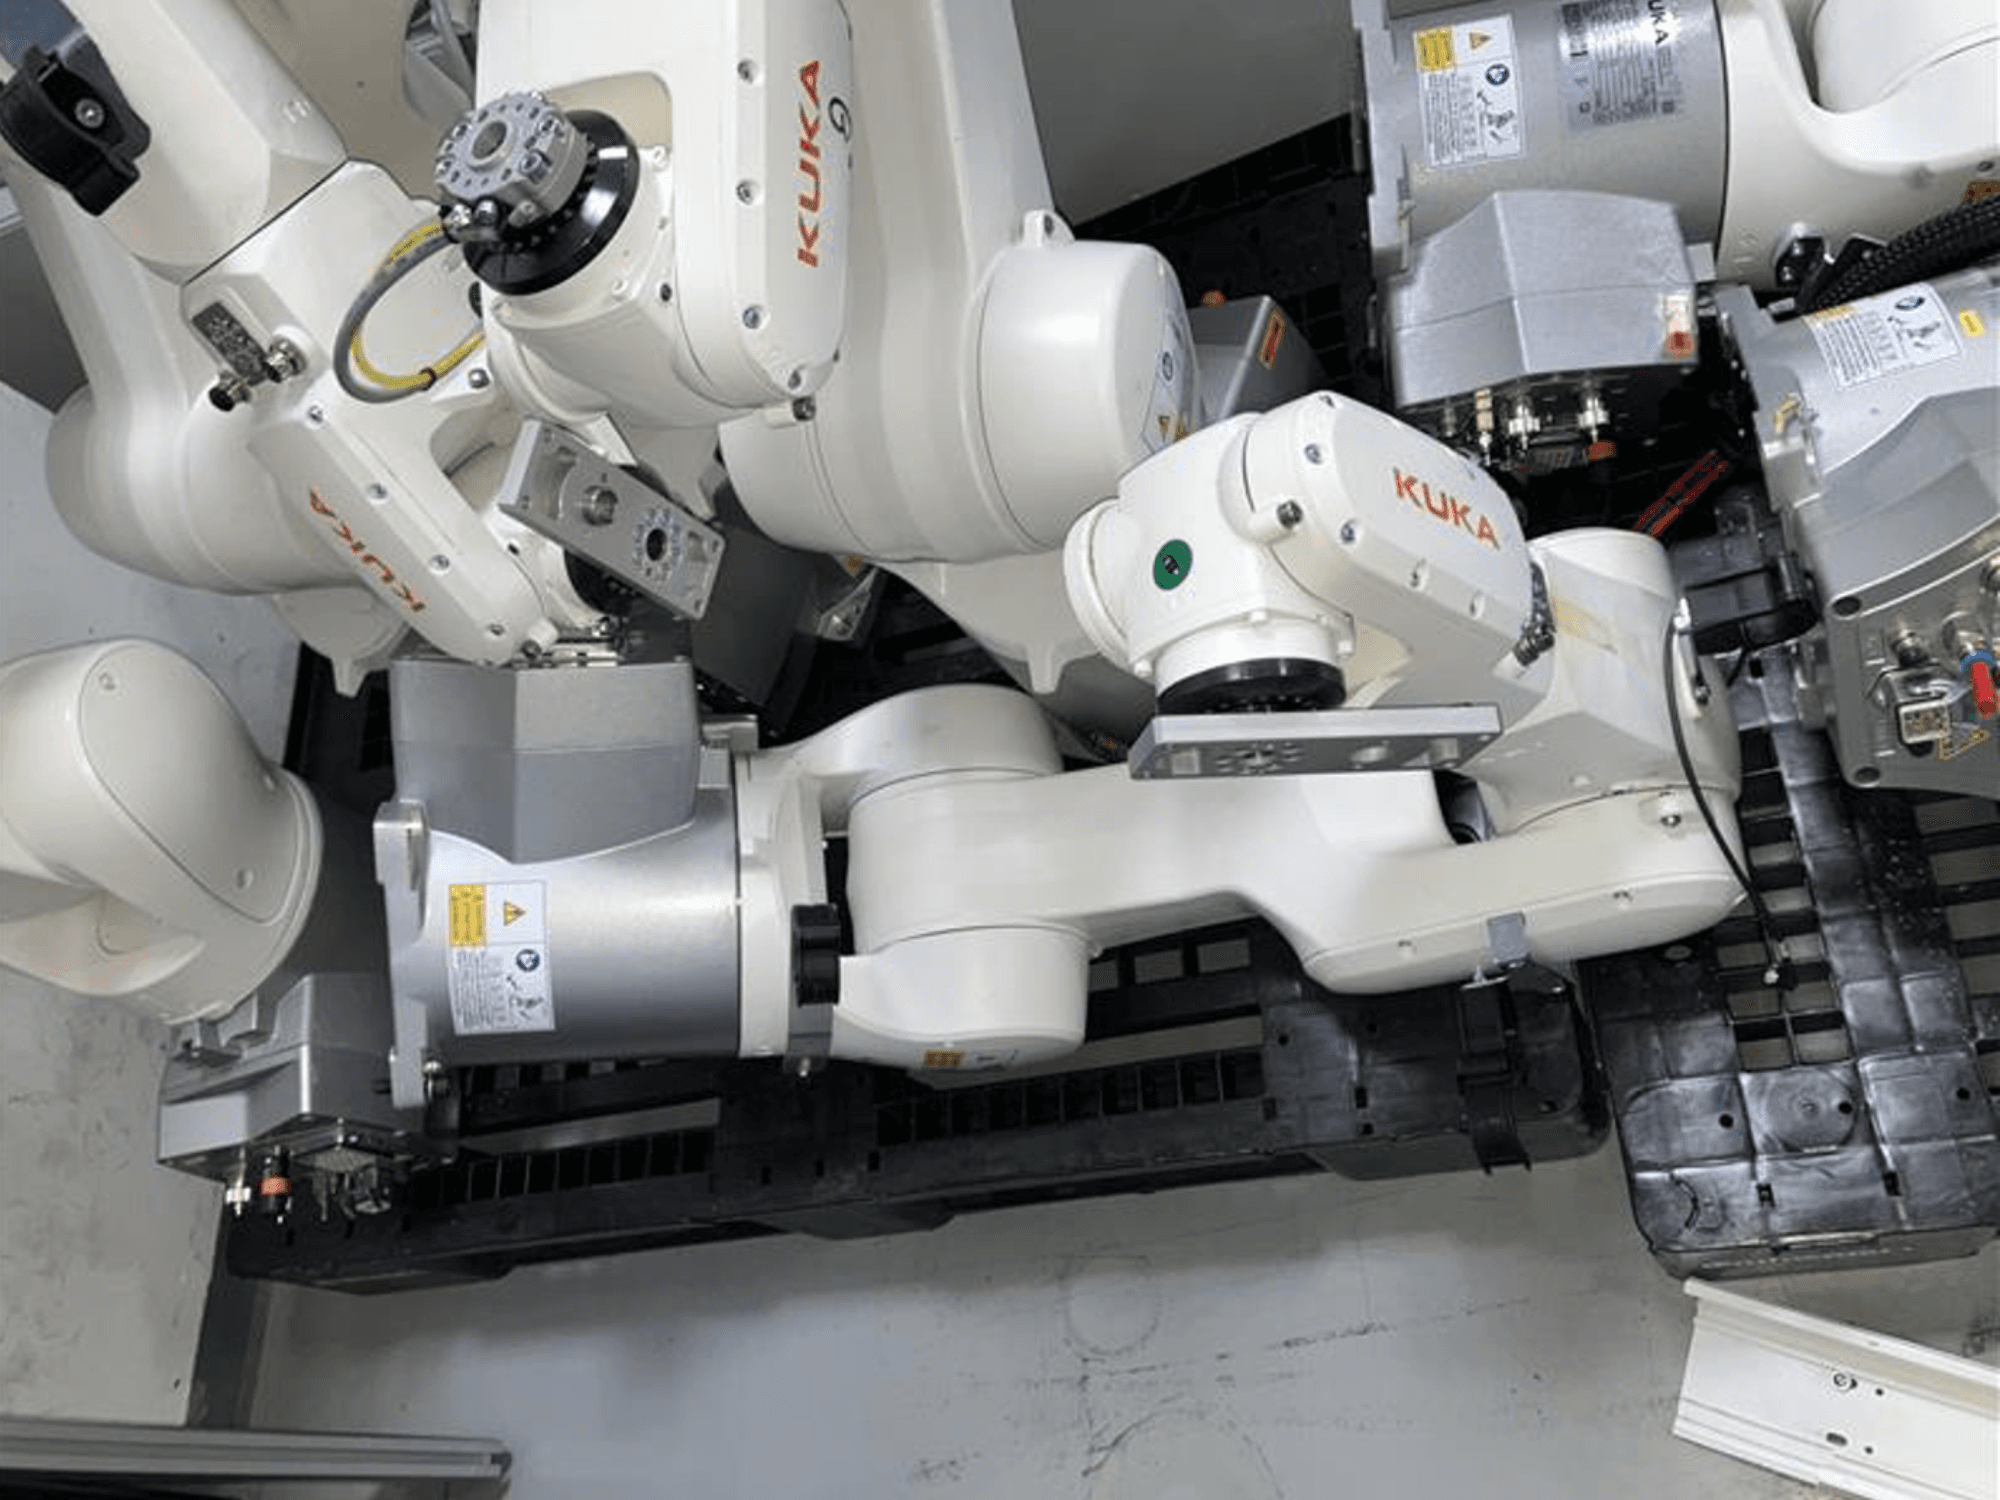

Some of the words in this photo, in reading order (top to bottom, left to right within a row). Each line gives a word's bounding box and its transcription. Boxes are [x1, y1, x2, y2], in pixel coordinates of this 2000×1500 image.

[798, 60, 820, 267] KUKA
[309, 488, 426, 612] KUKA
[1393, 466, 1500, 550] KUKA
